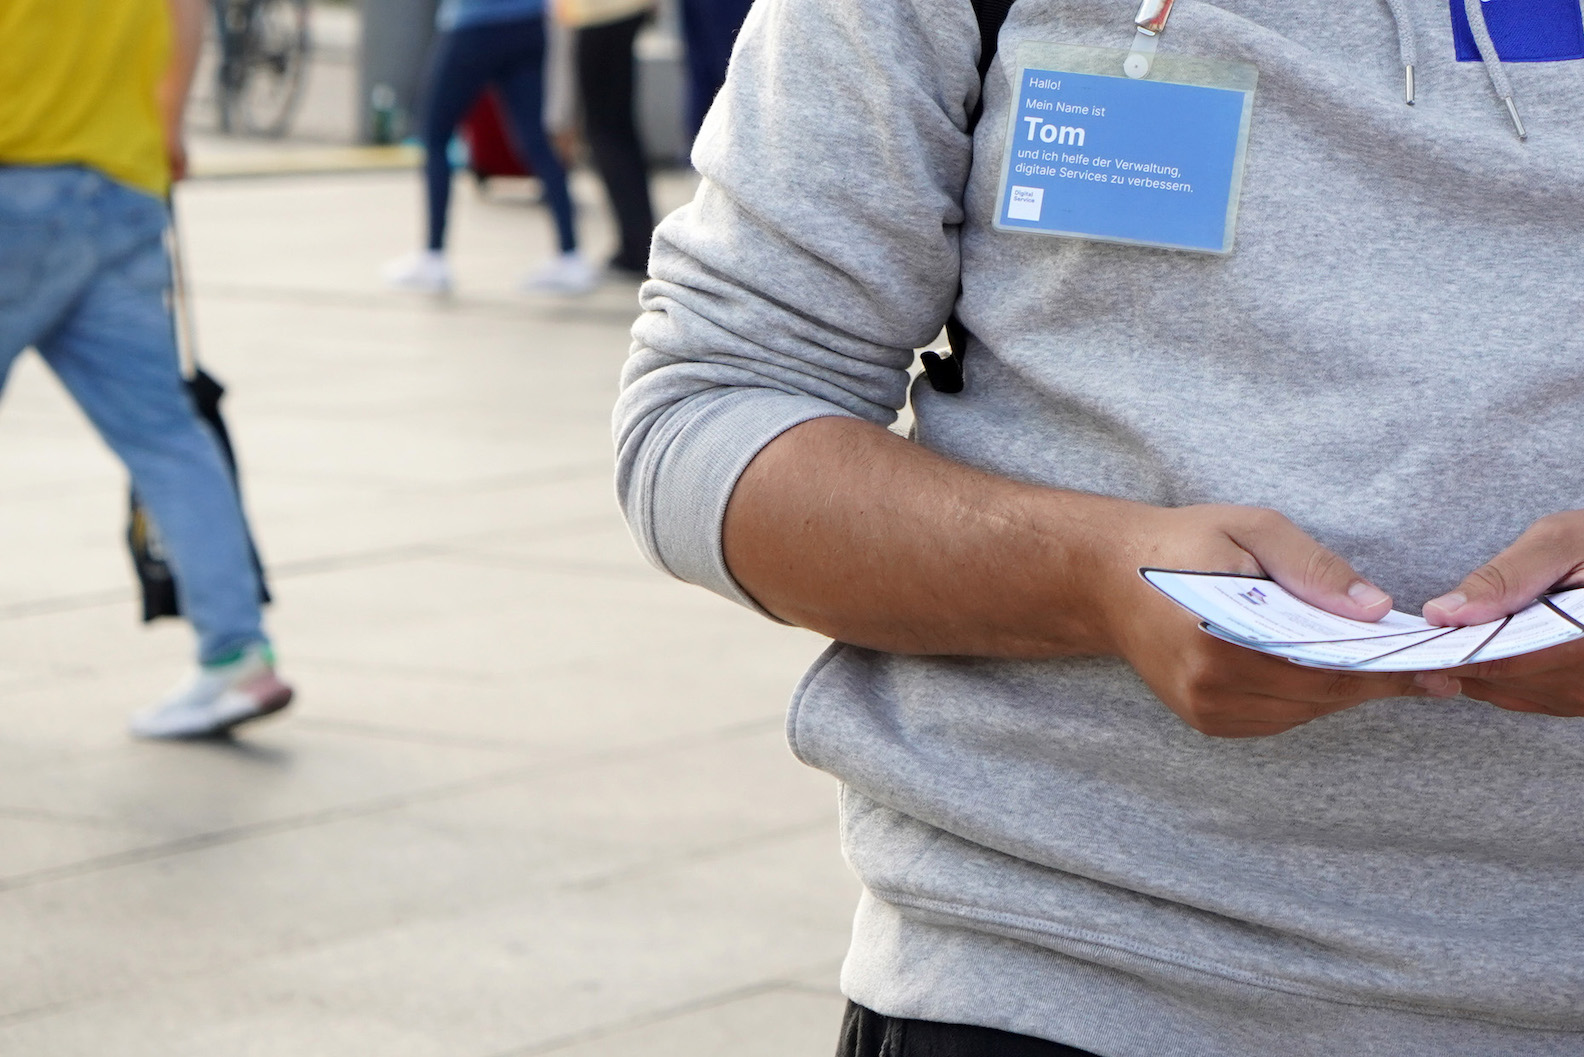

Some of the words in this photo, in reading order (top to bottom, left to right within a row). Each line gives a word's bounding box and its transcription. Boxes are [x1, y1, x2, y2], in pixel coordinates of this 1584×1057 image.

[1029, 77, 1061, 91] Hallo!
[1025, 98, 1053, 111] Mein
[1056, 102, 1089, 115] Name
[1091, 105, 1106, 117] ist
[1023, 116, 1086, 147] Tom
[1017, 149, 1039, 160] und
[1042, 150, 1058, 162] ich
[1061, 152, 1089, 165] helfe
[1092, 156, 1111, 168] der
[1114, 158, 1182, 178] Verwaltung,
[1015, 163, 1056, 177] digitale
[1059, 167, 1108, 183] Services
[1110, 175, 1125, 185] zu
[1127, 178, 1194, 193] verbessern.
[1013, 195, 1035, 203] Service
[1014, 189, 1034, 198] Digital
